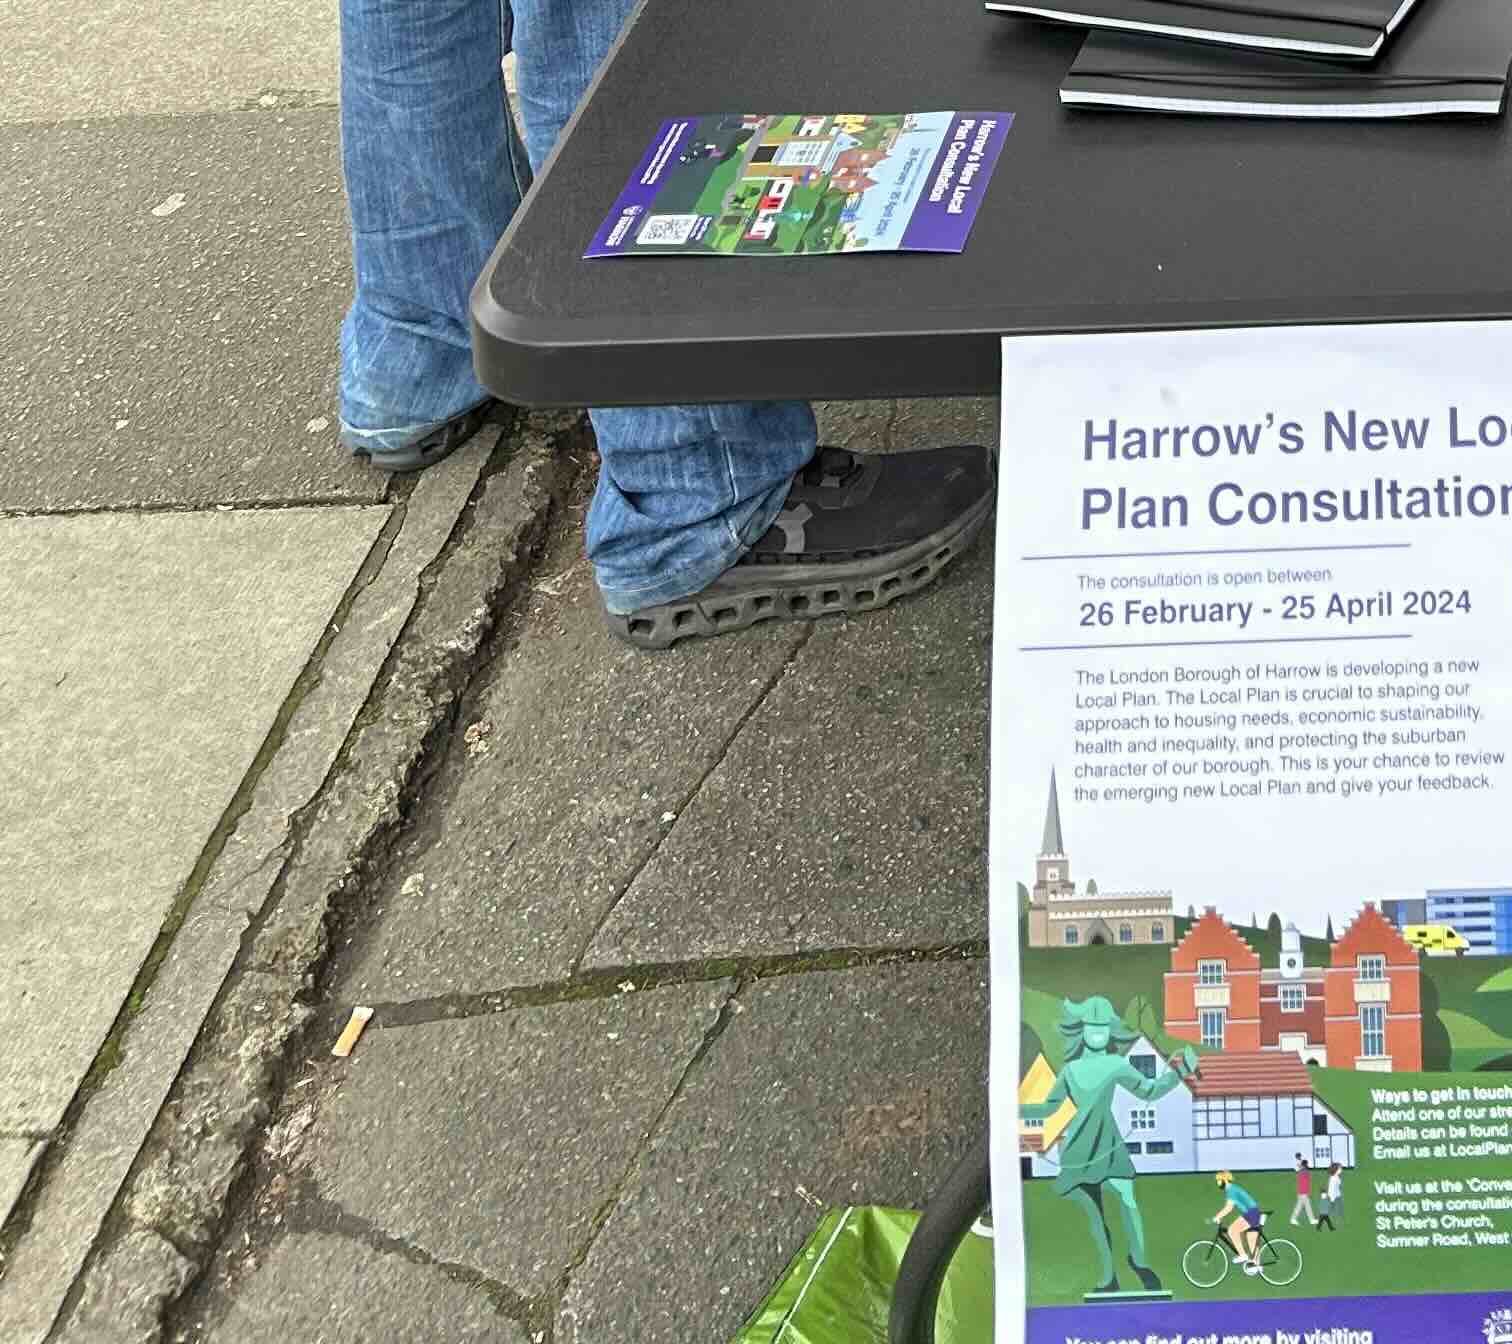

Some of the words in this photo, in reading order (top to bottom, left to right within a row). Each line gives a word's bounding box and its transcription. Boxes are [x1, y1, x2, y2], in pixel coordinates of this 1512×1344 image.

[953, 118, 976, 141] Plan
[958, 161, 980, 186] New
[946, 186, 971, 214] Local
[1083, 411, 1305, 462] Harrow's
[1323, 408, 1431, 453] New
[1081, 486, 1189, 531] Plan
[1076, 574, 1107, 592] The
[1109, 572, 1203, 591] consultation
[1206, 572, 1220, 586] is
[1222, 571, 1263, 588] open
[1266, 567, 1333, 585] between
[1078, 601, 1114, 627] 26
[1124, 599, 1255, 630] February
[1262, 606, 1274, 614] -
[1281, 595, 1316, 621] 25
[1324, 592, 1393, 625] April
[1402, 590, 1472, 616] 2024
[1074, 669, 1106, 686] The
[1109, 668, 1170, 686] London
[1173, 663, 1242, 686] Borough
[1245, 663, 1261, 681] of
[1264, 663, 1322, 680] Harrow
[1325, 663, 1339, 678] is
[1342, 659, 1430, 679] developing
[1433, 661, 1444, 674] a
[1447, 659, 1480, 674] new
[1075, 692, 1118, 710] Local
[1164, 689, 1196, 706] The
[1199, 687, 1242, 706] Local
[1246, 686, 1280, 704] Plan
[1284, 689, 1299, 703] is
[1301, 683, 1354, 703] crucial
[1357, 684, 1374, 701] to
[1376, 682, 1441, 702] shaping
[1444, 682, 1471, 697] our
[1073, 714, 1150, 737] approach
[1153, 714, 1170, 730] to
[1173, 711, 1238, 732] housing
[1297, 707, 1376, 726] economic
[1074, 738, 1123, 755] health
[1126, 735, 1158, 754] and
[1244, 733, 1275, 750] and
[1278, 731, 1359, 753] protecting
[1362, 730, 1388, 746] the
[1390, 727, 1467, 745] suburban
[1073, 761, 1148, 779] character
[1151, 759, 1168, 777] of
[1171, 759, 1199, 777] our
[1278, 754, 1312, 773] This
[1316, 756, 1330, 771] is
[1332, 756, 1369, 775] your
[1372, 751, 1431, 769] chance
[1434, 751, 1451, 768] to
[1454, 750, 1506, 767] review
[1073, 784, 1099, 802] the
[1102, 785, 1179, 805] emerging
[1182, 784, 1216, 799] new
[1219, 779, 1263, 798] Local
[1266, 778, 1302, 796] Plan
[1305, 777, 1336, 795] and
[1340, 778, 1374, 799] give
[1376, 777, 1414, 797] your
[1370, 1088, 1412, 1108] Ways
[1411, 1087, 1430, 1103] to
[1429, 1087, 1456, 1106] get
[1455, 1085, 1472, 1102] in
[1371, 1106, 1417, 1123] Attend
[1417, 1108, 1446, 1122] one
[1446, 1105, 1463, 1121] of
[1463, 1106, 1488, 1120] our
[1372, 1125, 1420, 1142] Details
[1419, 1126, 1447, 1141] can
[1448, 1124, 1468, 1140] be
[1468, 1122, 1510, 1139] found
[1372, 1143, 1412, 1160] Email
[1412, 1145, 1432, 1159] us
[1432, 1143, 1448, 1158] at
[1373, 1180, 1404, 1195] Visit
[1404, 1181, 1424, 1195] us
[1424, 1180, 1440, 1195] at
[1440, 1179, 1464, 1194] the
[1374, 1197, 1420, 1216] during
[1420, 1197, 1444, 1213] the
[1374, 1215, 1392, 1231] St
[1375, 1233, 1431, 1249] Sumner
[1473, 1231, 1510, 1246] West
